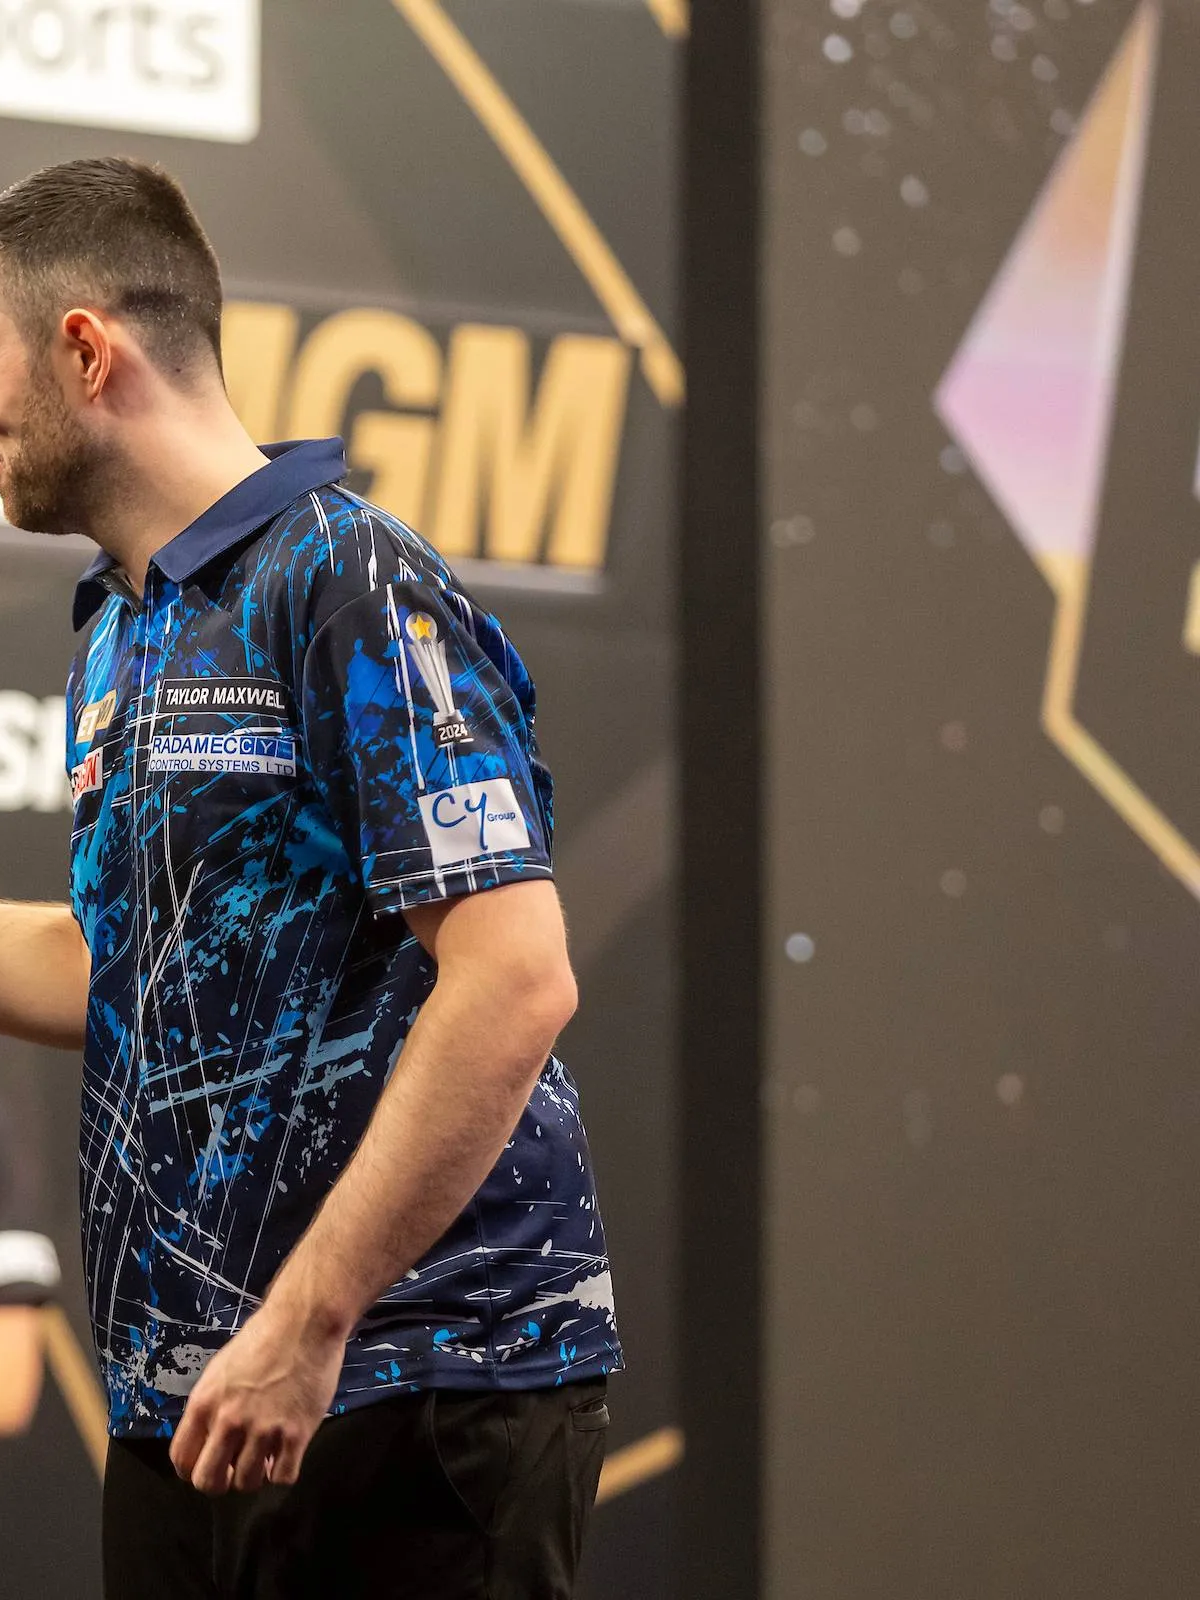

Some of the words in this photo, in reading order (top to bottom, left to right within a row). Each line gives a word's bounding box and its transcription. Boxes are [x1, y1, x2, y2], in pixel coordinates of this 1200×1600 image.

[165, 687, 209, 706] TAYLOR
[438, 723, 469, 742] 2024
[152, 736, 238, 755] RADAMEC
[149, 758, 195, 771] CONTROL
[198, 758, 260, 772] SYSTEMS
[265, 762, 295, 776] LTD
[487, 811, 516, 822] Group
